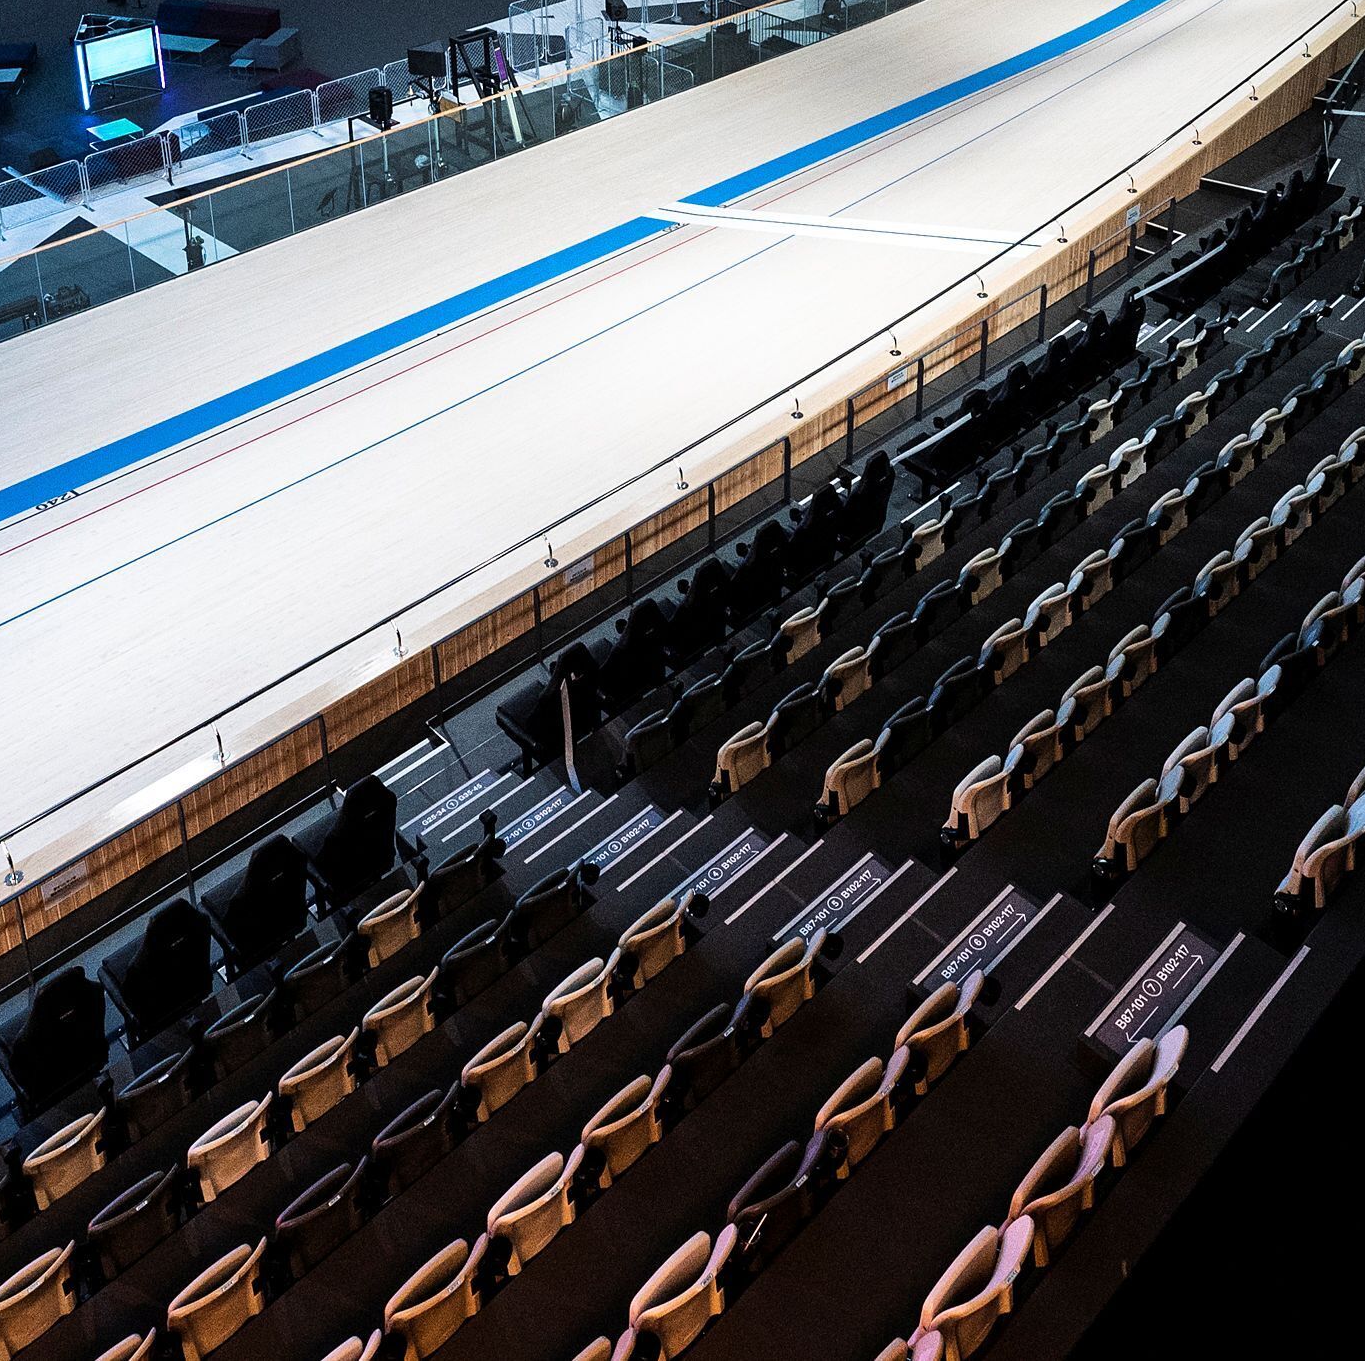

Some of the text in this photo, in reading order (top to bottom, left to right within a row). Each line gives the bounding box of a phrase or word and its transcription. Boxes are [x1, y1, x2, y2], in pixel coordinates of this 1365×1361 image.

[421, 807, 447, 826] G25-34
[457, 783, 483, 802] G35-45
[534, 798, 563, 822] B102-117
[620, 819, 651, 844] B102-117
[720, 843, 752, 870] B102-117
[798, 908, 831, 936] B87-101
[840, 869, 872, 900] B102-117
[940, 947, 974, 980] B87-101
[982, 903, 1015, 937] B102-117
[1114, 993, 1149, 1030] B87-101
[1155, 943, 1190, 982] B102-117
